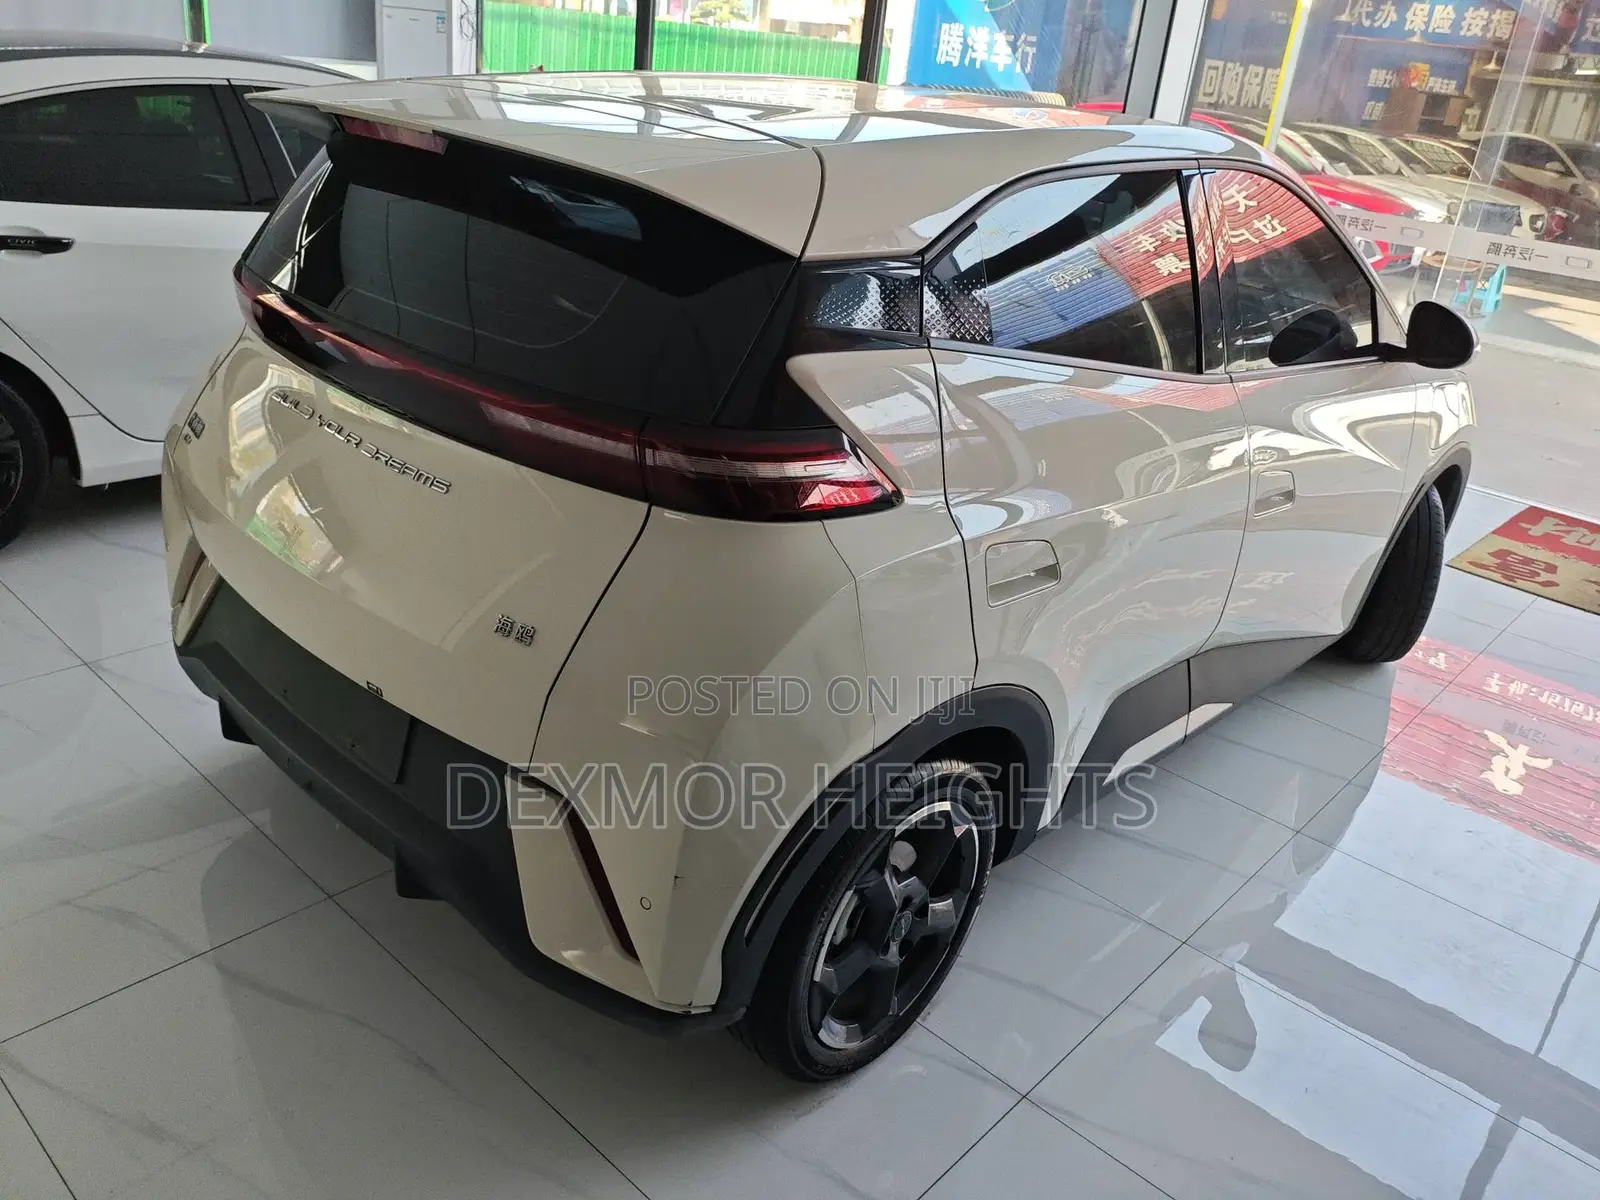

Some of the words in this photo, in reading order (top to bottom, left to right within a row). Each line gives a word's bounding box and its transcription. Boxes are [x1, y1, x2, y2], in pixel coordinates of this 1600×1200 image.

[1404, 3, 1456, 34] 保险
[1460, 7, 1517, 41] 按揭
[936, 22, 1037, 74] 腾洋车行
[271, 389, 315, 420] BUILD
[316, 414, 362, 448] YOUR
[361, 443, 452, 494] DREAMS
[493, 613, 537, 647] 海鸥
